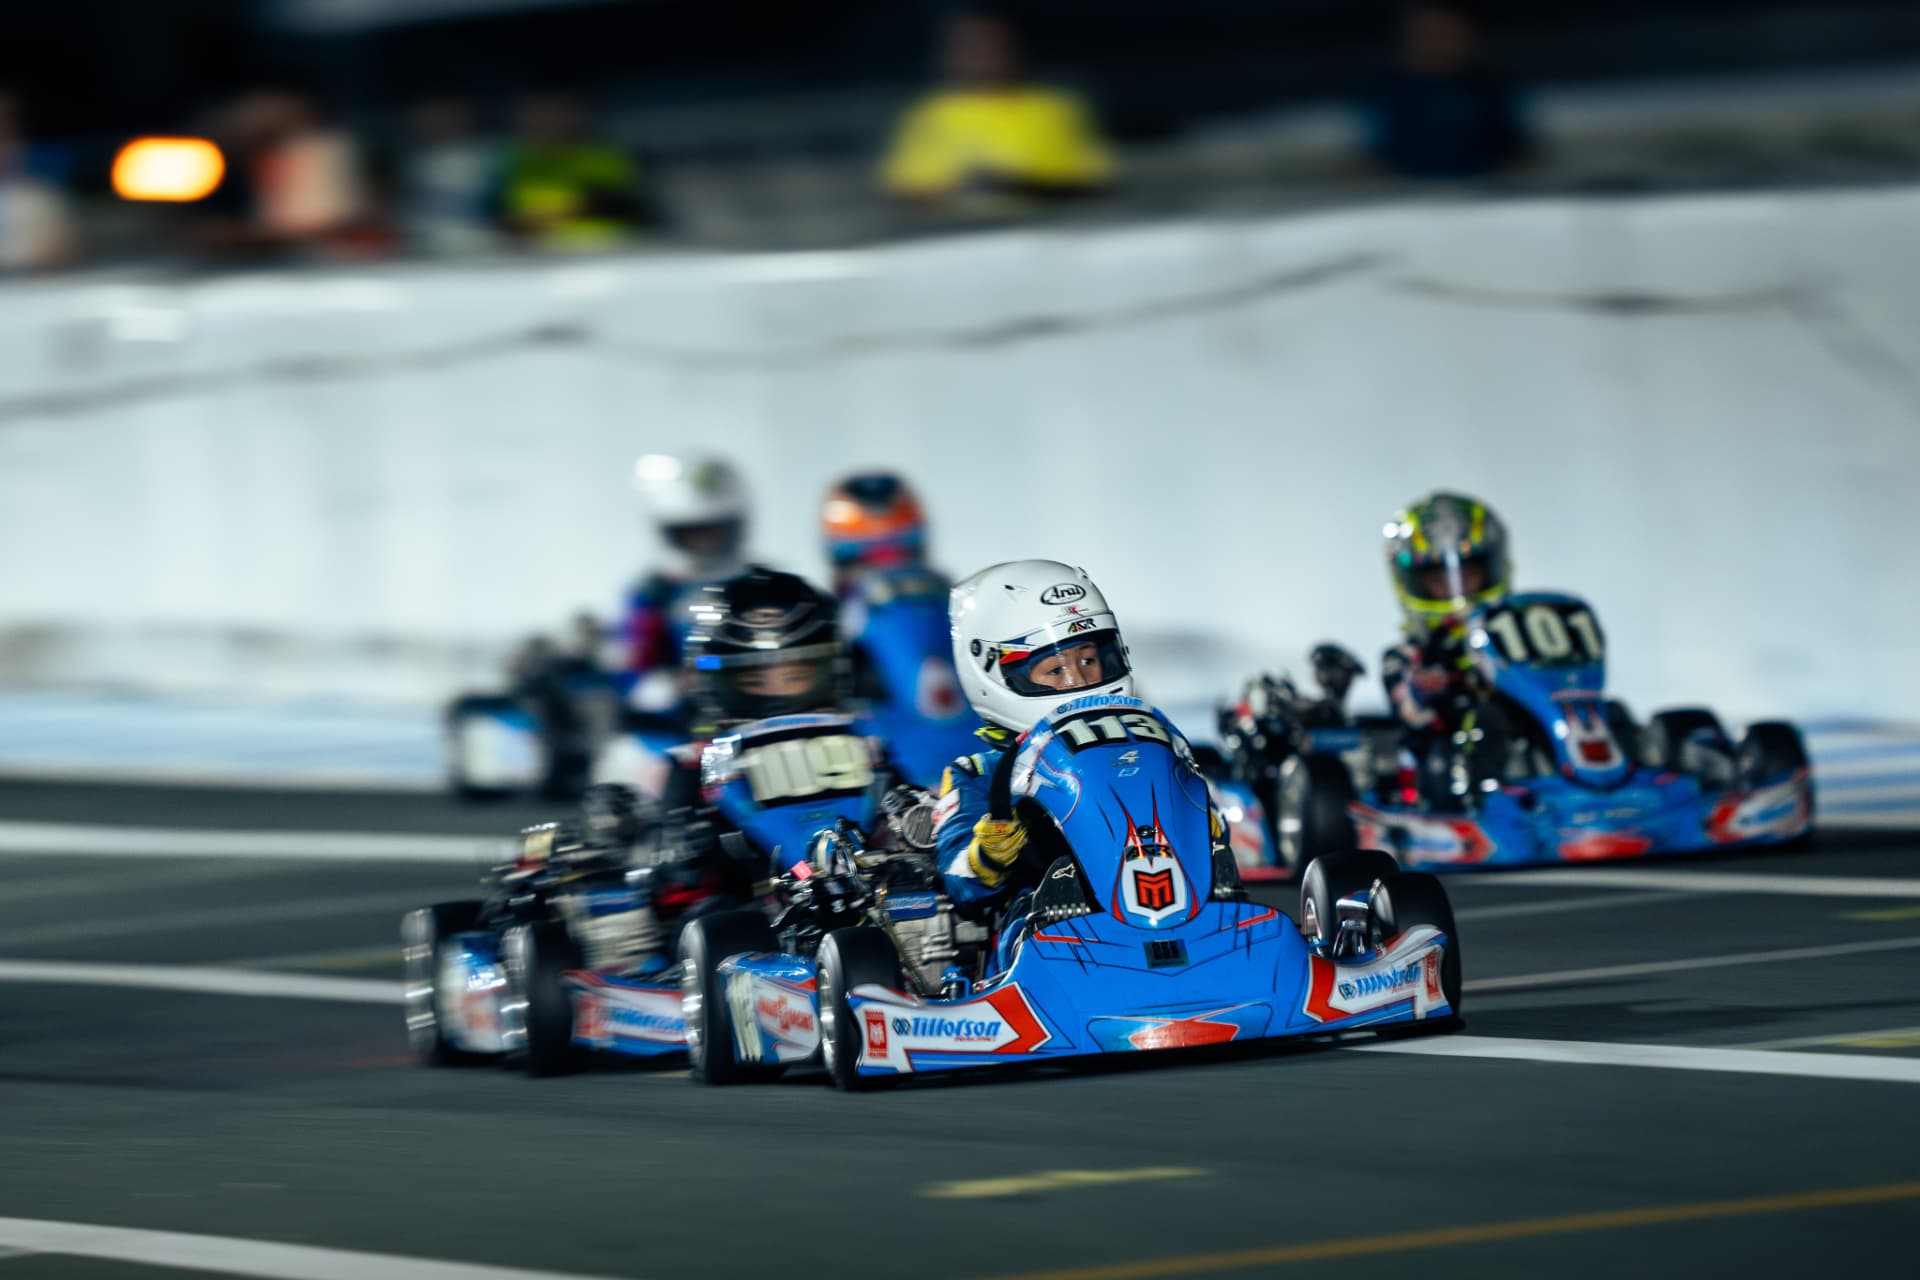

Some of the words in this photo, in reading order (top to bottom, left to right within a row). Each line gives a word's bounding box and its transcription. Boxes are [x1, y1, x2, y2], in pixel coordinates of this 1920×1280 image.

[1051, 586, 1081, 599] Arai
[1487, 605, 1602, 662] 101
[1055, 713, 1171, 746] 113
[912, 1016, 1002, 1038] Tillotson
